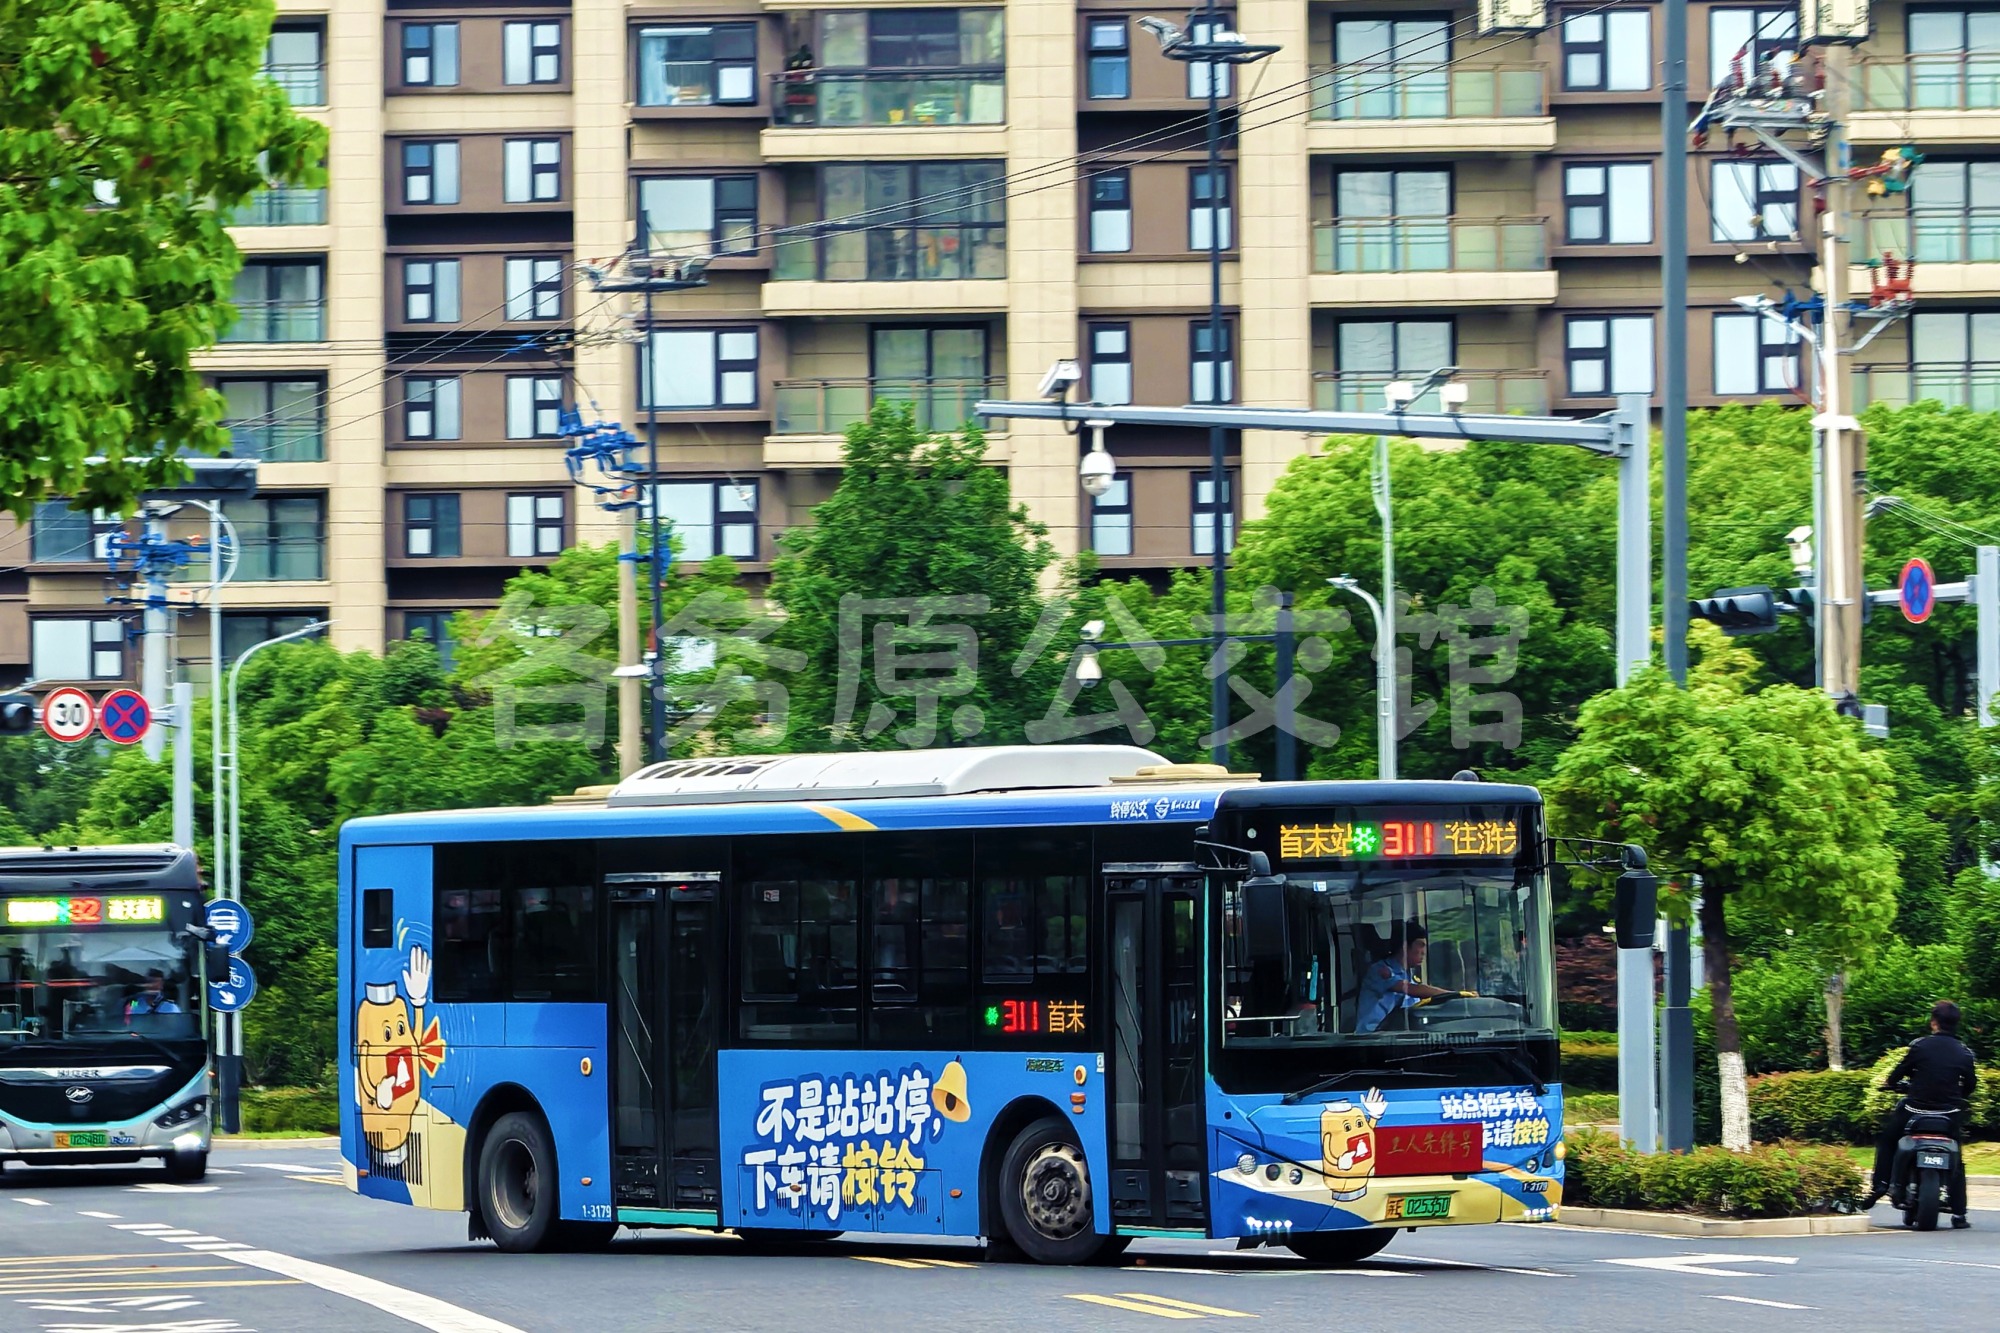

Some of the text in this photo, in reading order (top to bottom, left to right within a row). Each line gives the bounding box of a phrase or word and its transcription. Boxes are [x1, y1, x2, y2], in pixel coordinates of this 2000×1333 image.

[55, 703, 85, 726] 30
[1383, 822, 1433, 856] 311
[1002, 1000, 1085, 1032] 311 首末
[1387, 1130, 1473, 1158] 工人先锋号
[745, 1138, 924, 1220] 下车请按铃
